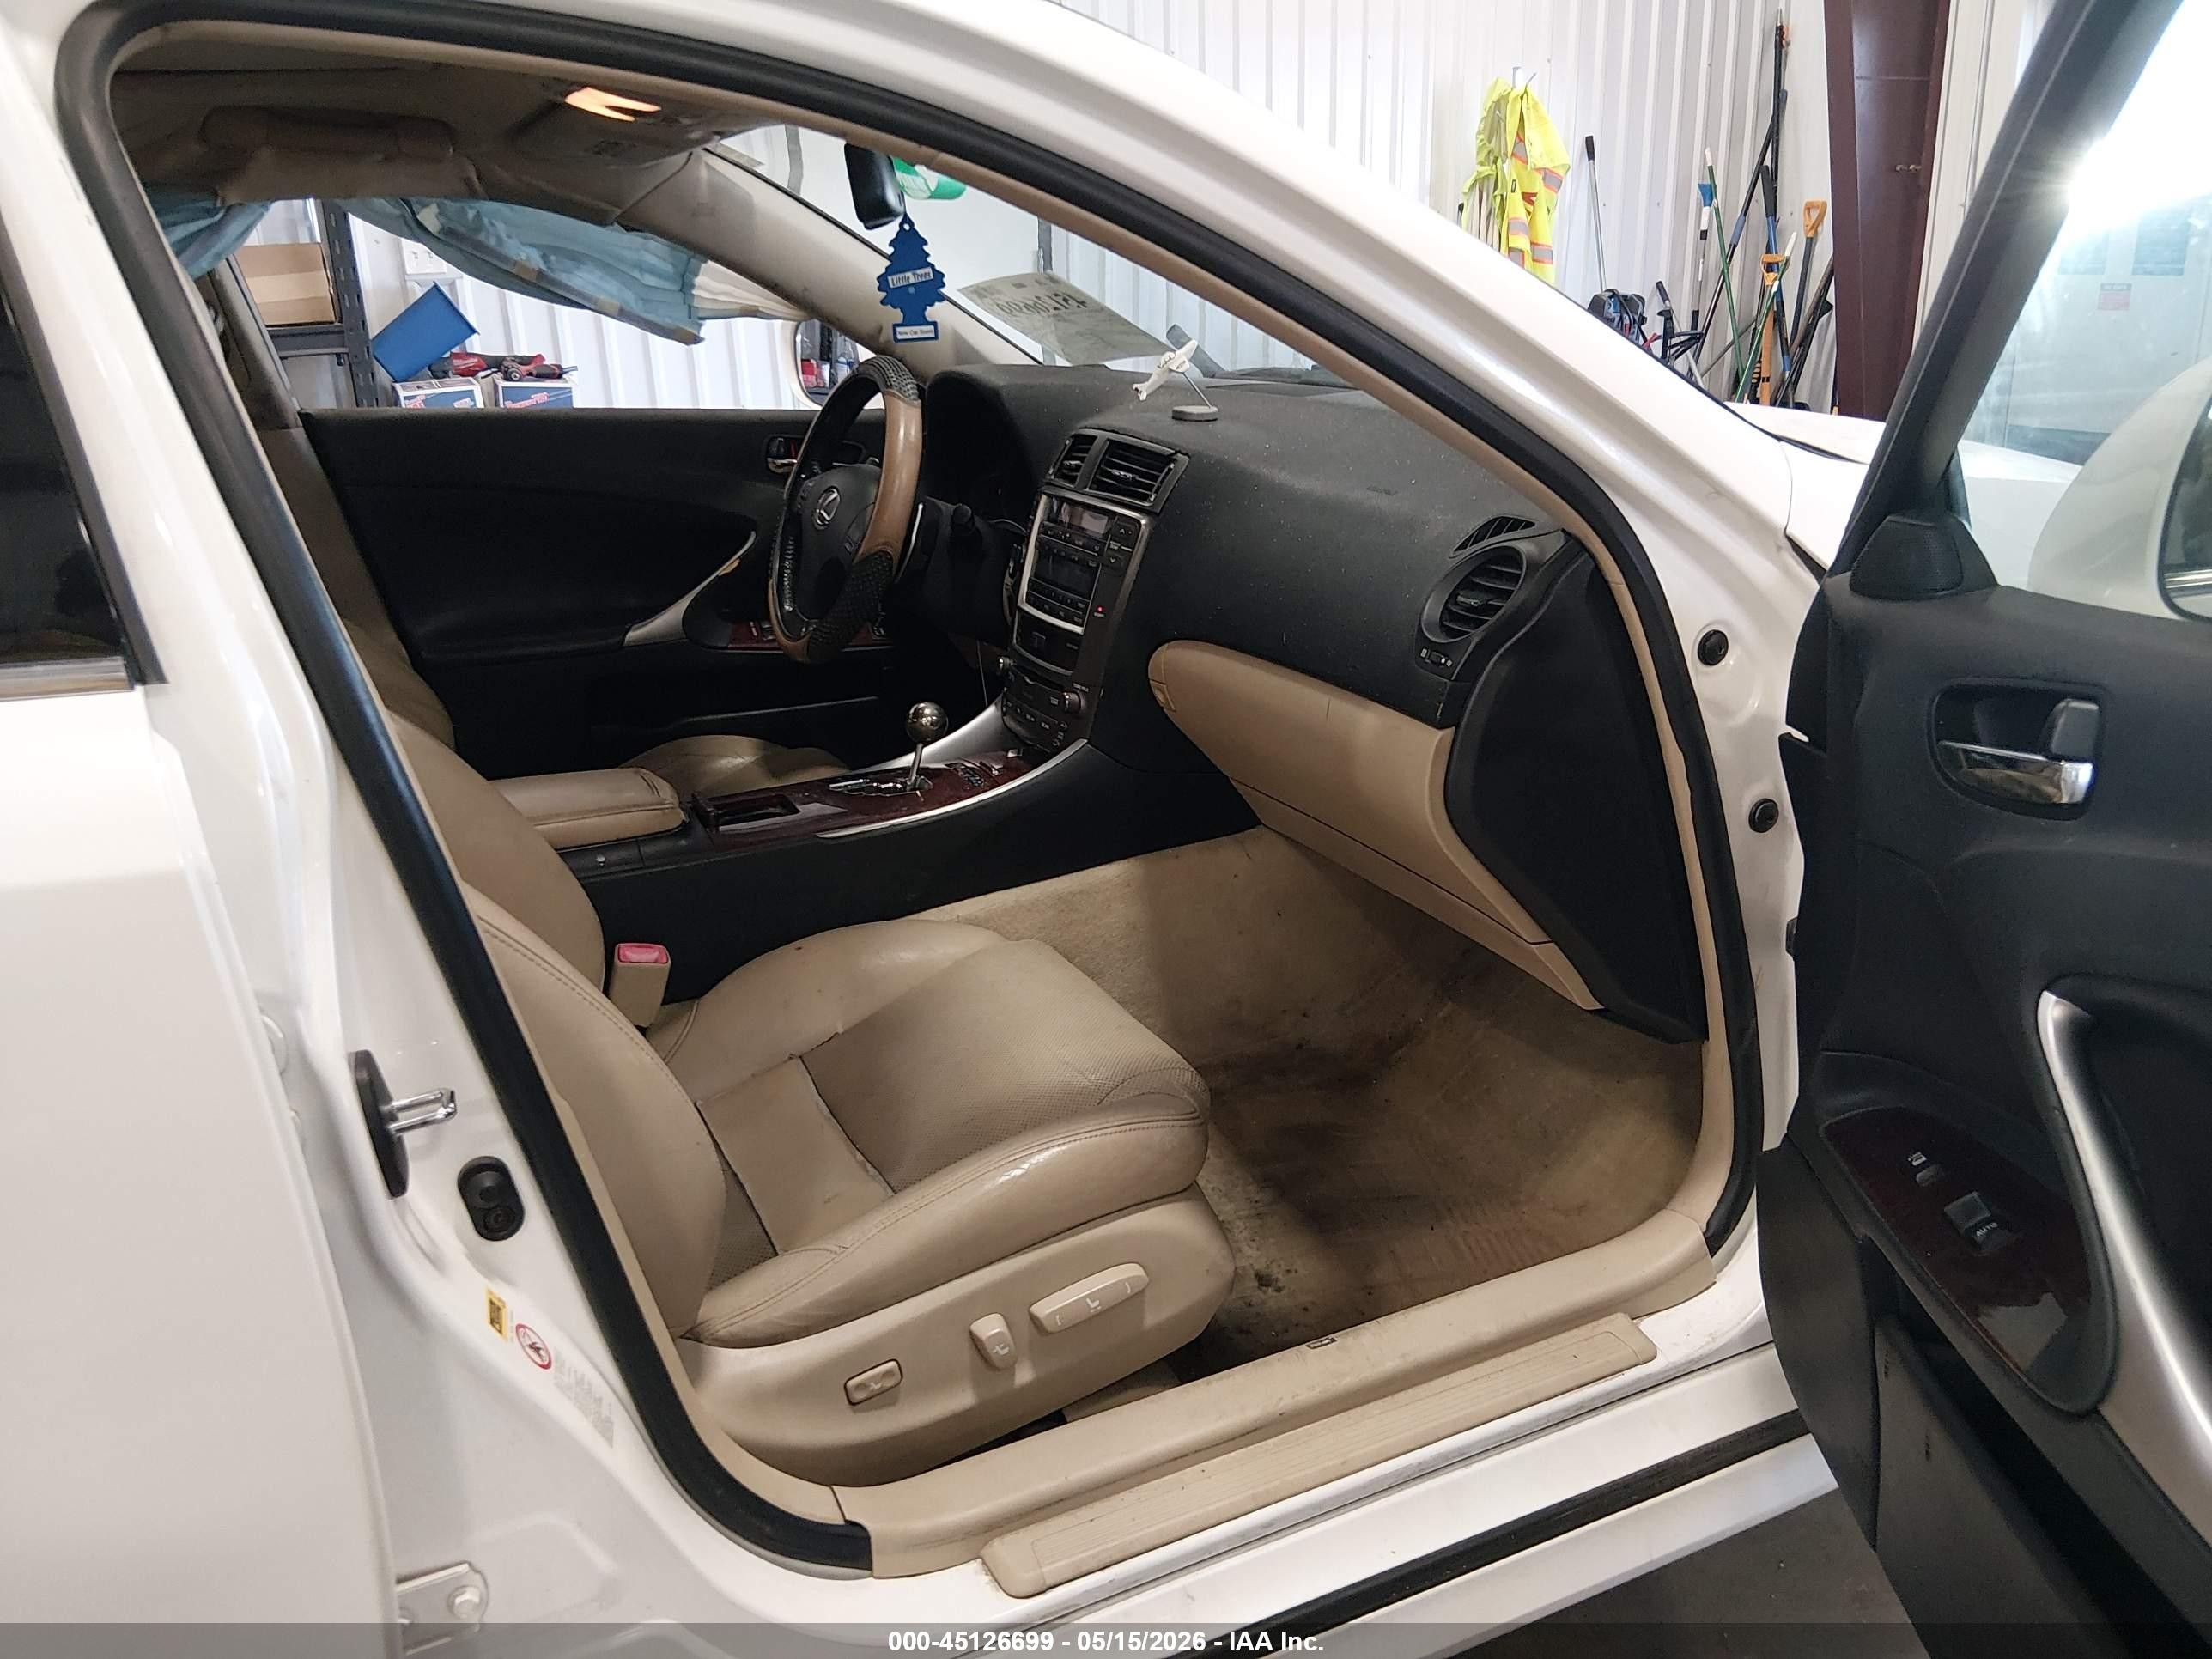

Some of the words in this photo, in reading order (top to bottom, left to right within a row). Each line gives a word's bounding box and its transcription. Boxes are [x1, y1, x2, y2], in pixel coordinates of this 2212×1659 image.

[890, 275, 910, 287] Little
[913, 270, 932, 282] Trees
[1976, 1222, 1998, 1237] AUTO
